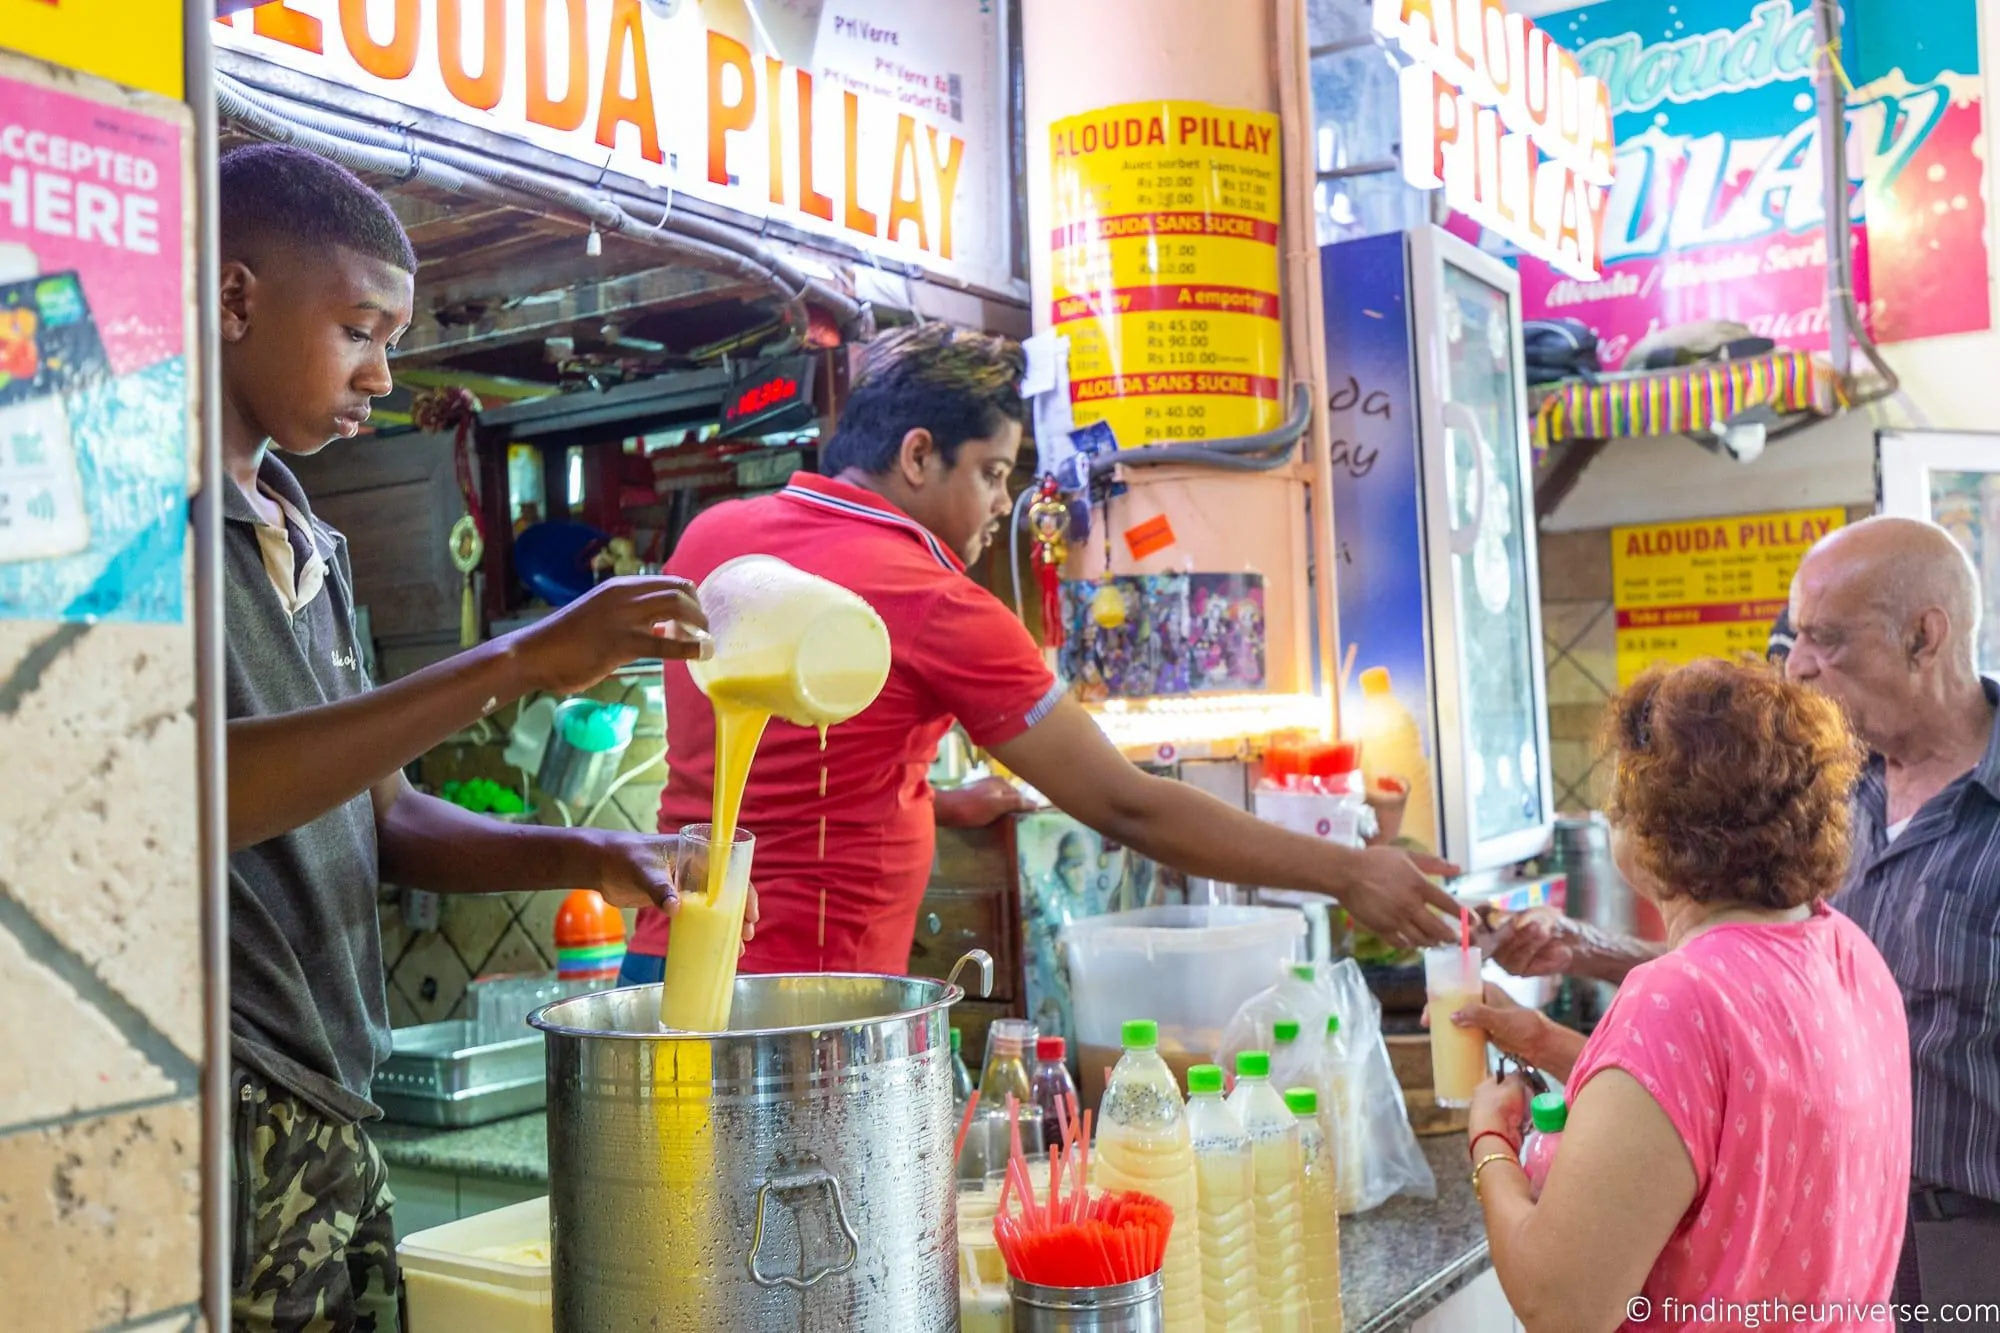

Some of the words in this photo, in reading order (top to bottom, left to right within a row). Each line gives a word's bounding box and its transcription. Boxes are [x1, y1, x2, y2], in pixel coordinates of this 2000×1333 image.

[0, 124, 158, 190] CCEPTED
[706, 29, 965, 261] PILLAY
[1055, 116, 1166, 159] ALOUDA
[1178, 116, 1273, 156] PILLAY
[0, 164, 160, 256] HERE
[1155, 215, 1201, 233] SANS
[1204, 216, 1255, 237] SUCRE
[1076, 377, 1144, 400] ALOUDA
[1145, 374, 1194, 393] SANS
[1197, 375, 1250, 393] SUCRE
[1625, 526, 1729, 559] ALOUDA
[1739, 517, 1833, 549] PILLAY
